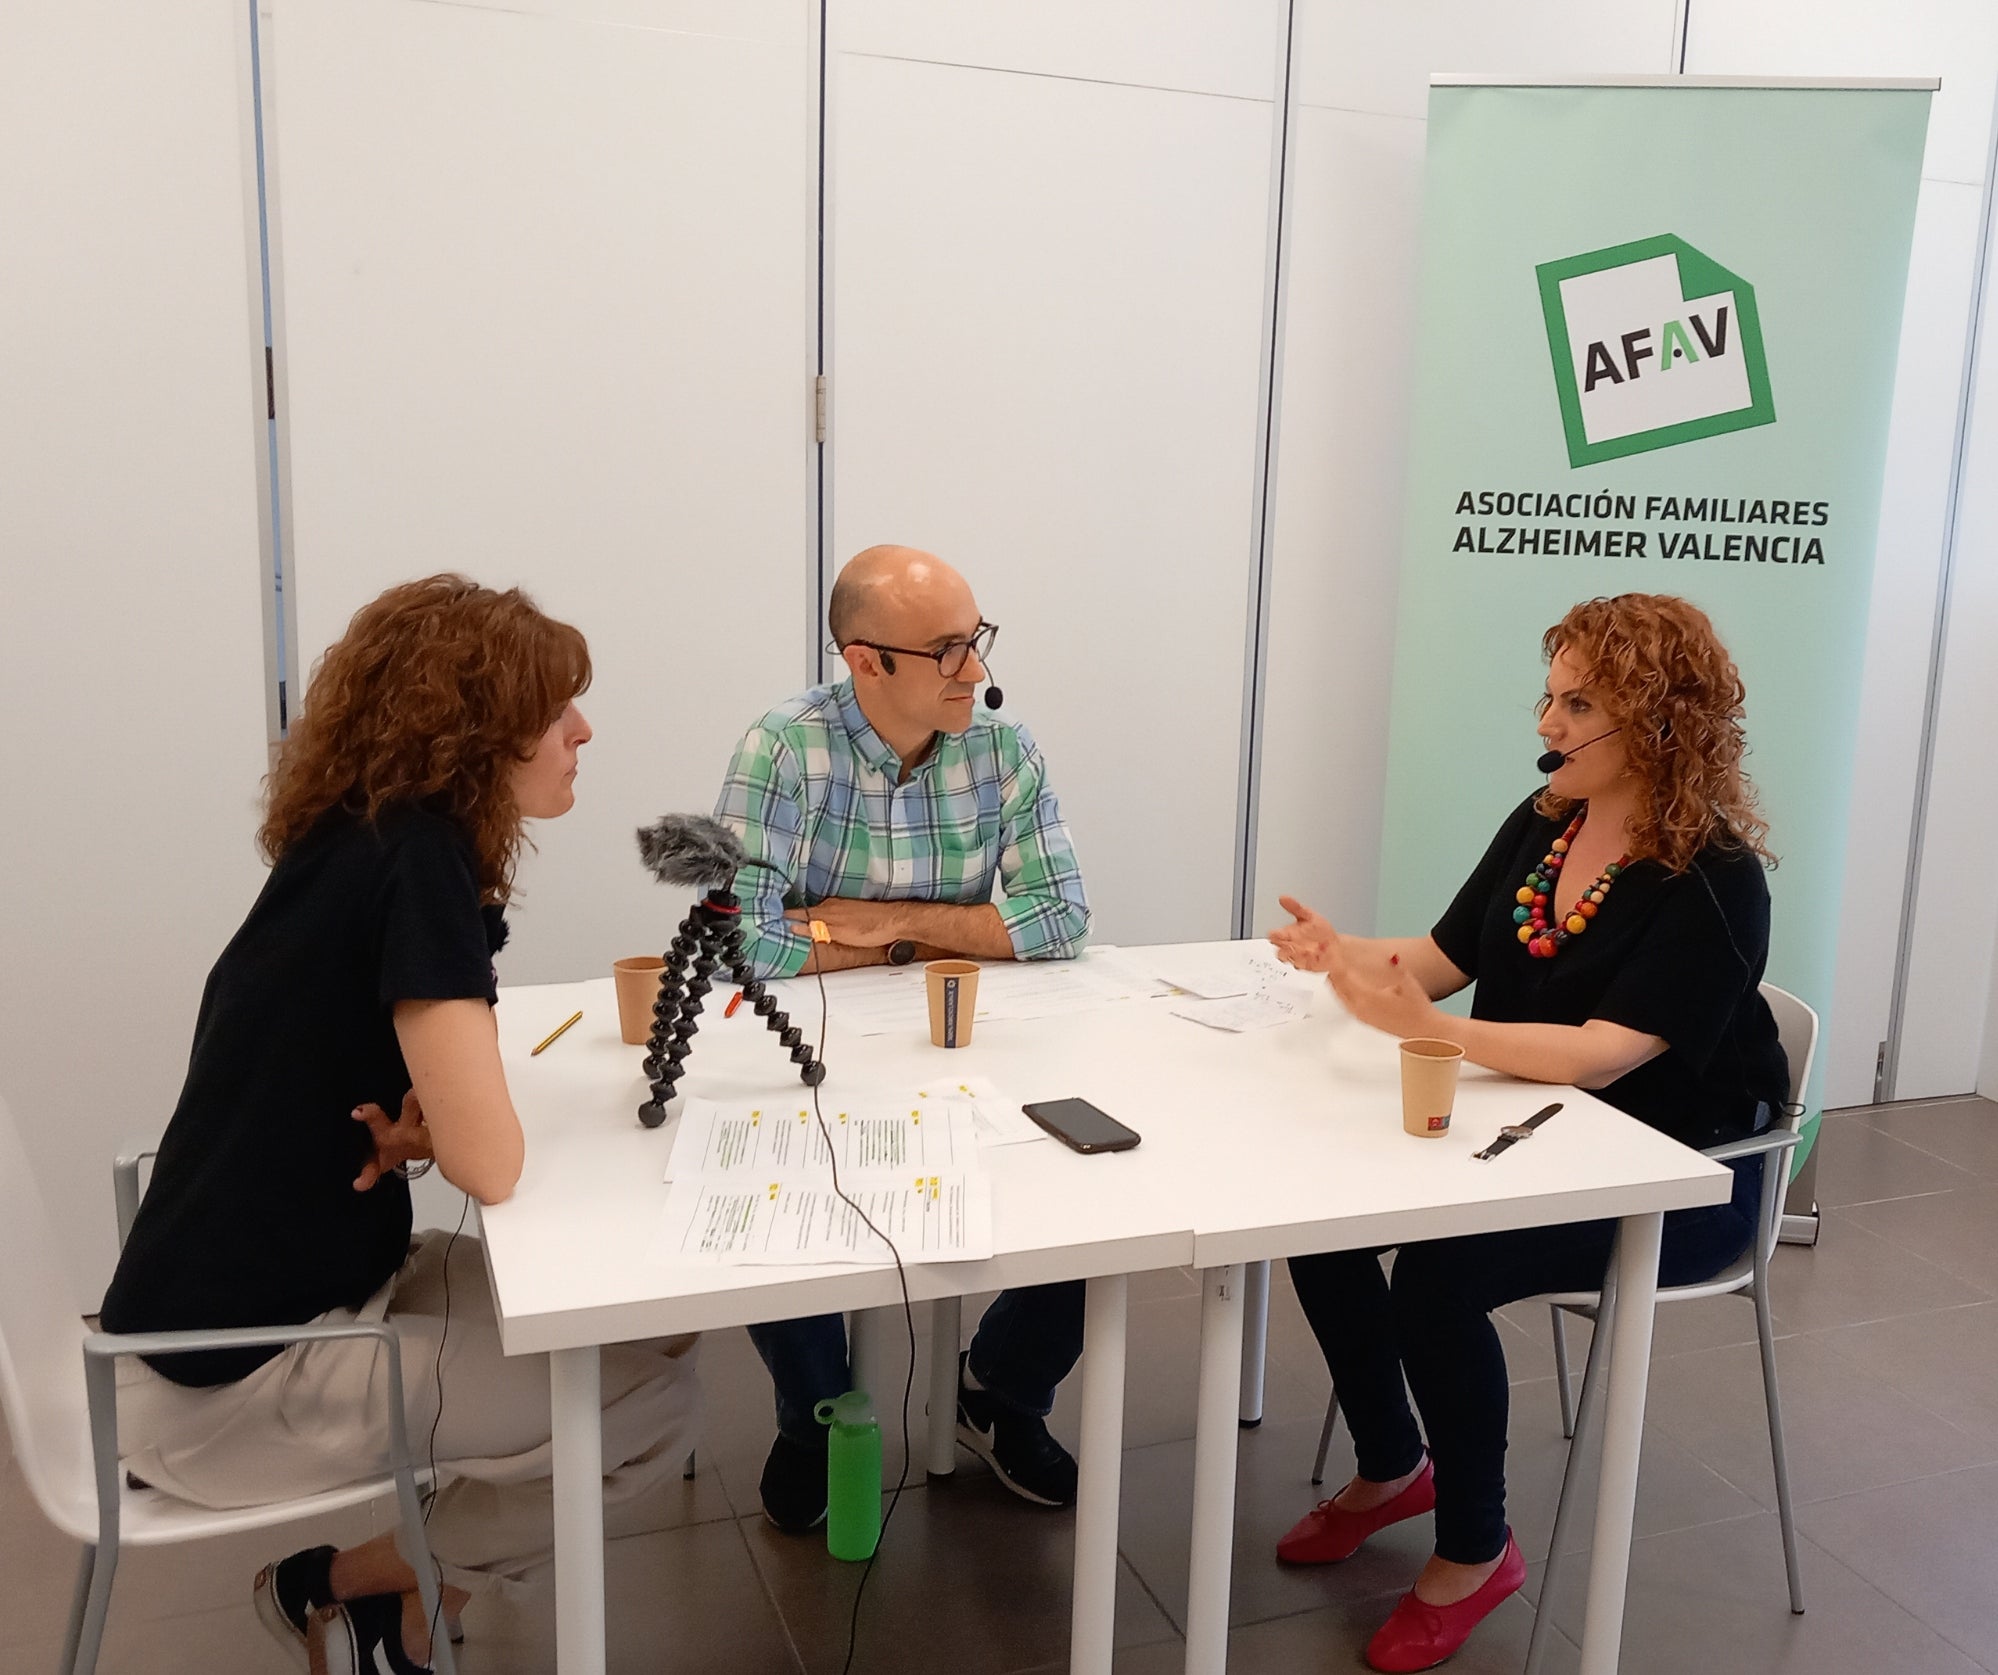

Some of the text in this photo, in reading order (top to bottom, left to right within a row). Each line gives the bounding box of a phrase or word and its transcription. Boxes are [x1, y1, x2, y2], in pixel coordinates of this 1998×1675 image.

[1583, 305, 1729, 394] AFAV
[1455, 488, 1830, 527] ASOCIACIÓN FAMILIARES
[1452, 526, 1825, 565] ALZHEIMER VALENCIA
